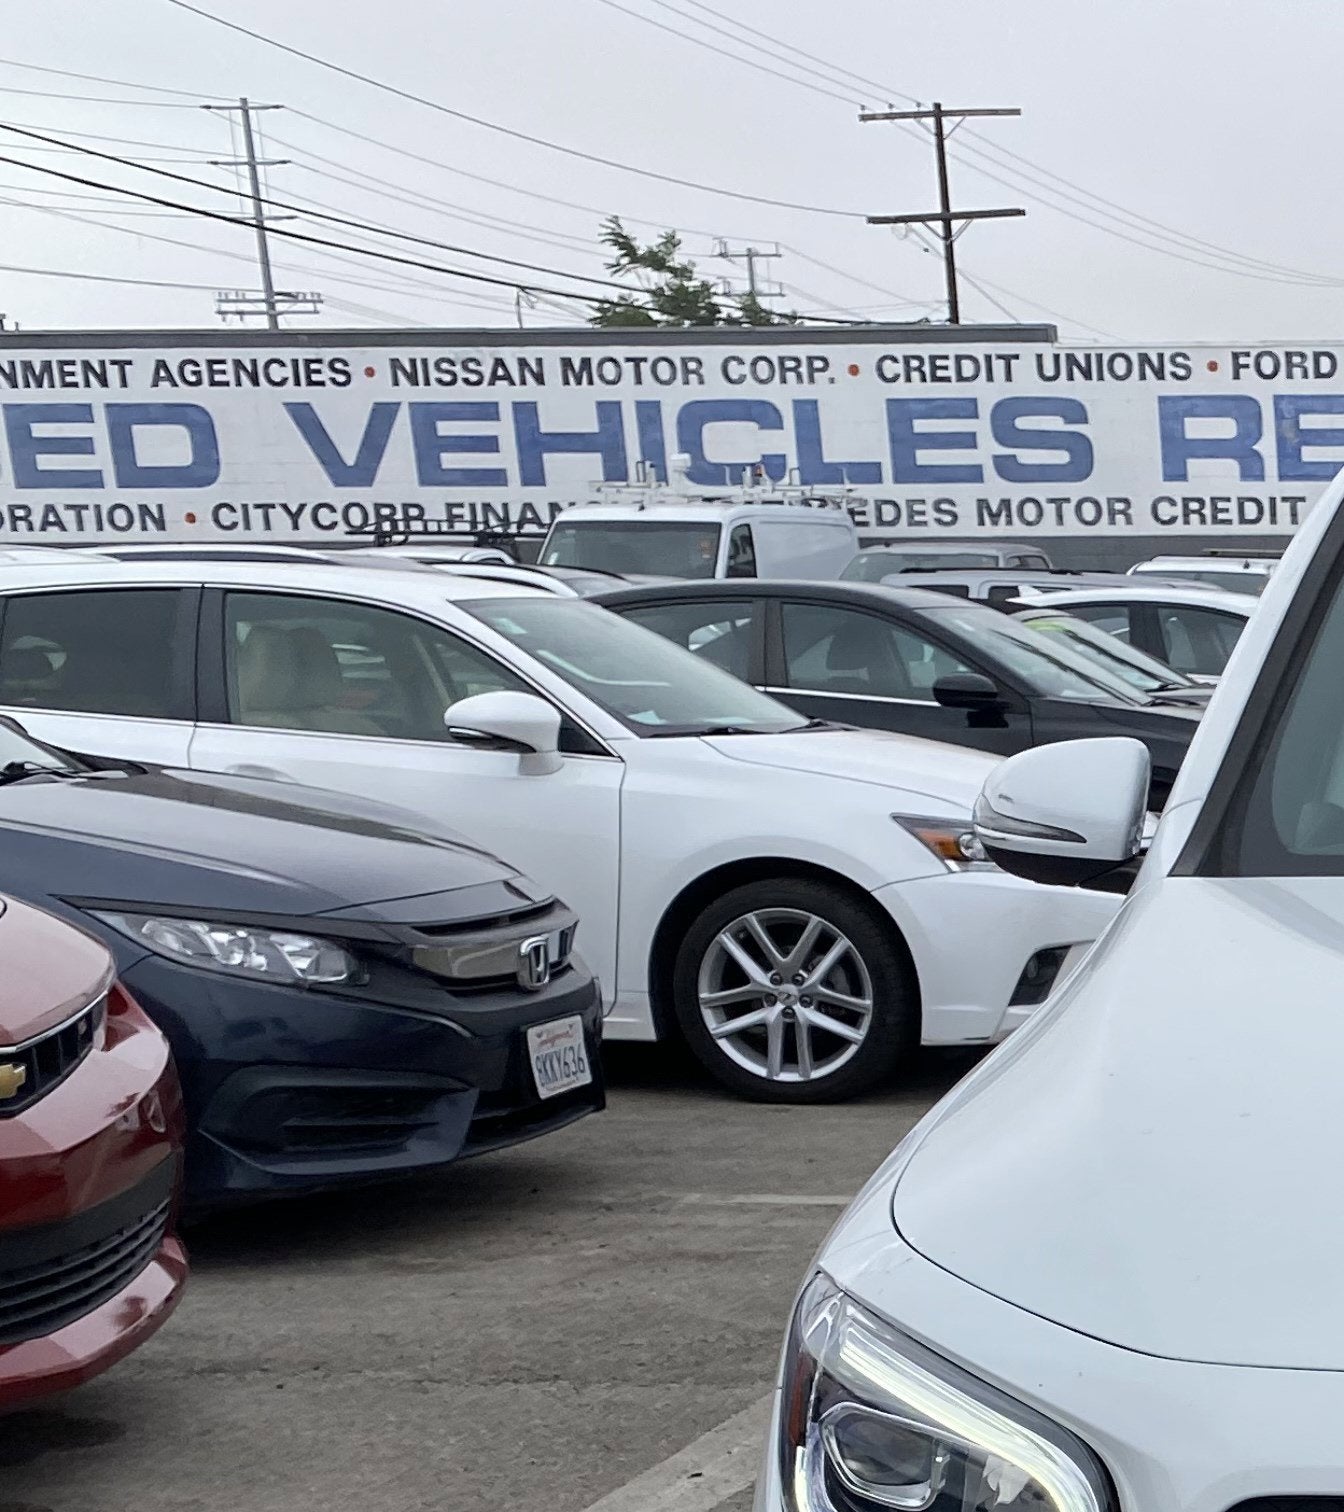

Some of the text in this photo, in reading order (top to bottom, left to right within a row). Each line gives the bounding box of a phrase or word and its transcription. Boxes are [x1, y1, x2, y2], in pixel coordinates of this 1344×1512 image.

[0, 359, 133, 389] NMENT
[150, 357, 352, 388] AGENCIES
[389, 356, 546, 387] NISSAN
[559, 355, 705, 386] MOTOR
[720, 355, 836, 385] CORP.
[875, 353, 1020, 383] CREDIT
[1035, 352, 1192, 383] UNIONS
[1231, 350, 1338, 381] FORD
[283, 396, 1094, 488] VEHICLES
[0, 502, 167, 533] RATION
[211, 501, 425, 533] CITYCORP
[977, 497, 1133, 527] MOTOR
[1151, 495, 1306, 526] CREDIT
